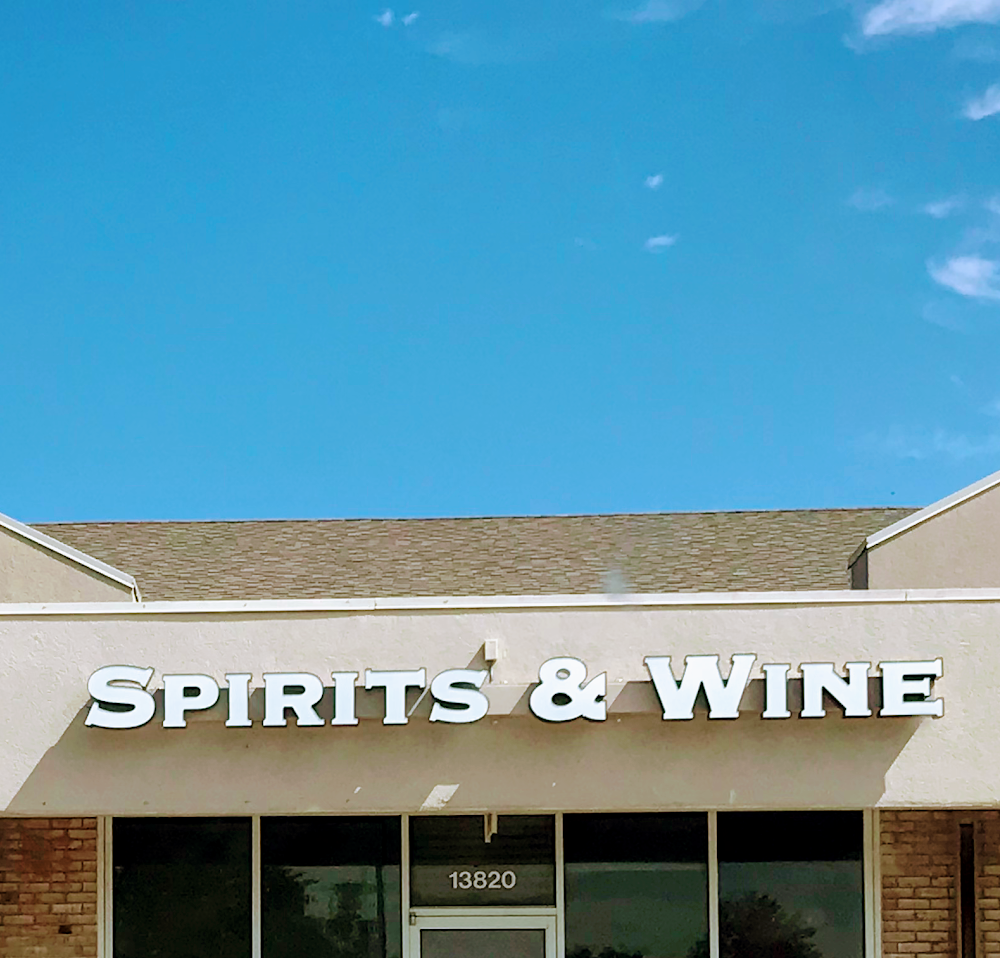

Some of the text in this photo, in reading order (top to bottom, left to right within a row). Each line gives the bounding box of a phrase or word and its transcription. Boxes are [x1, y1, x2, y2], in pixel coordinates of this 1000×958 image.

[85, 652, 945, 730] SPIRITS & WINE
[449, 870, 517, 889] 13820
